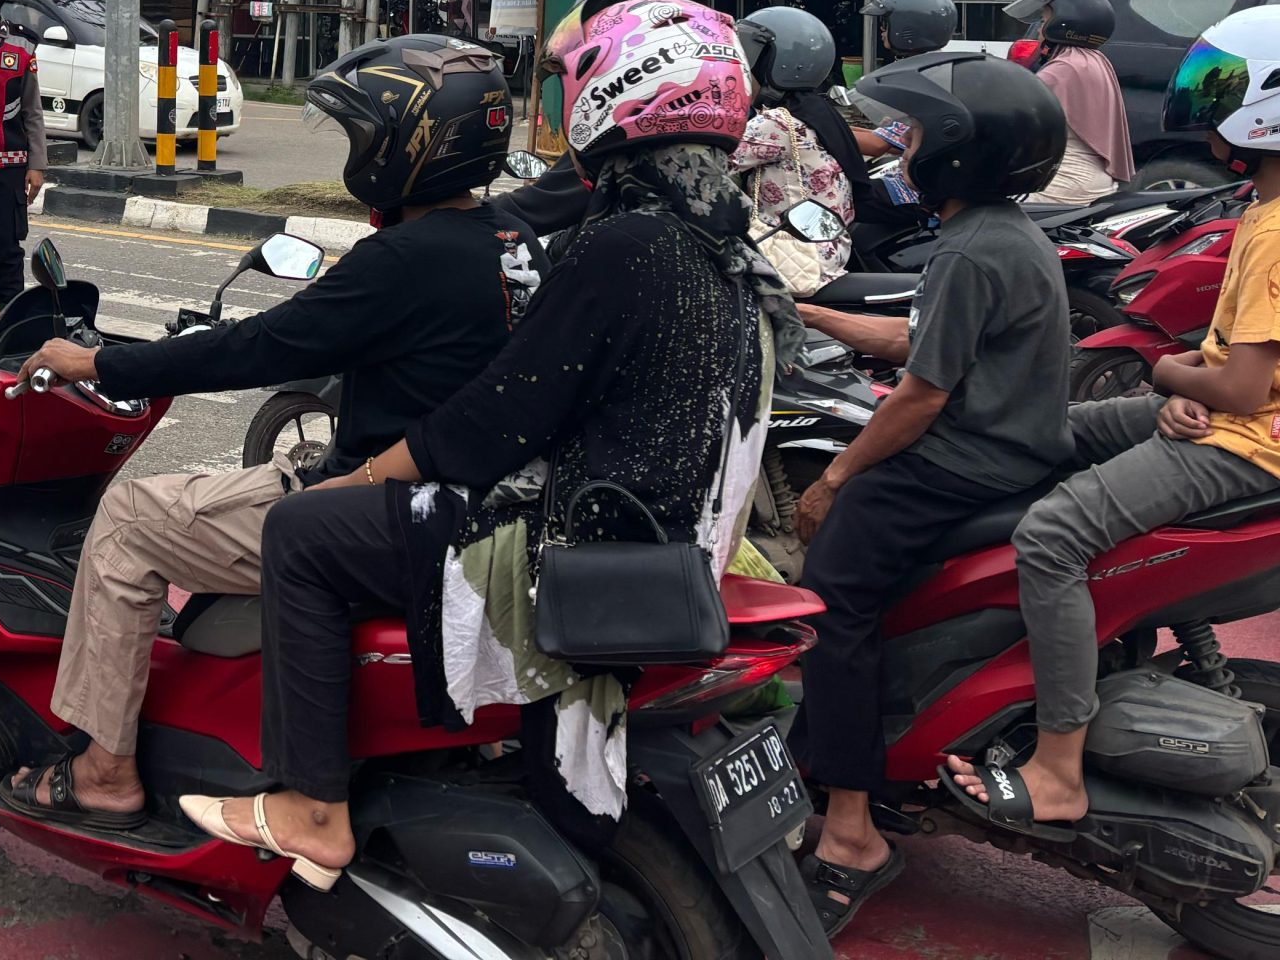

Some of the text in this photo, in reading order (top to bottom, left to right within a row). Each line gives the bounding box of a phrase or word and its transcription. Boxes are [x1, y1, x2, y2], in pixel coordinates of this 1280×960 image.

[54, 100, 64, 109] 23
[480, 90, 505, 105] JPX
[591, 47, 675, 110] Sweet
[405, 109, 435, 163] JPX
[708, 735, 783, 813] DA 5251 UP
